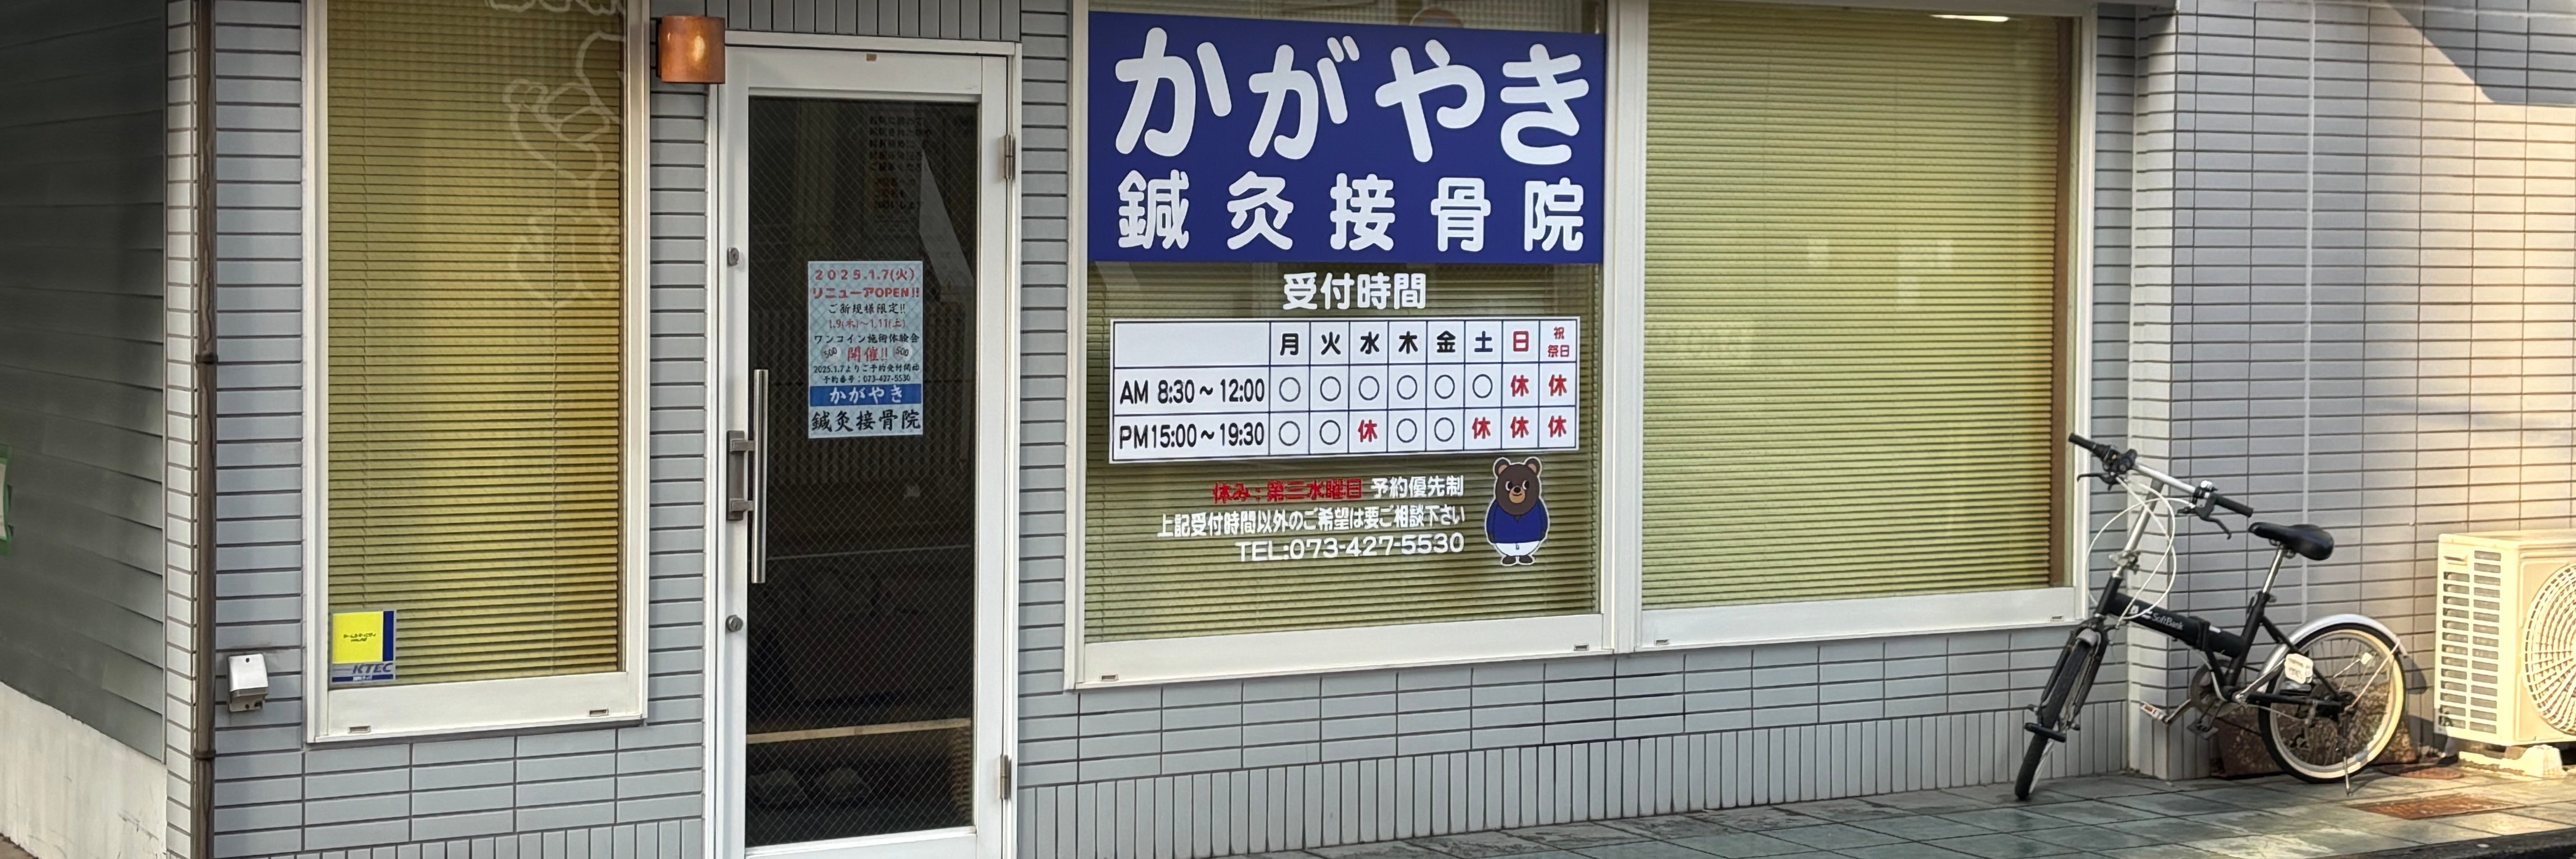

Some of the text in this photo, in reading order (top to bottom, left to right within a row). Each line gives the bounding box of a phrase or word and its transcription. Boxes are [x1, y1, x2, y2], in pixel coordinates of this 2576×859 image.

[1115, 28, 1589, 165] かがやき
[1118, 169, 1585, 252] 鍼灸接骨院
[1283, 272, 1427, 310] 受付時間
[1280, 330, 1530, 356] 月 火 水 木 金 土 日
[1553, 326, 1565, 340] 祝
[1548, 344, 1570, 358] 祭日
[829, 384, 902, 404] かがやき
[1120, 380, 1148, 405] AM
[1511, 374, 1529, 397] 休
[1548, 374, 1567, 397] 休
[811, 409, 921, 432] 鍼灸接骨院
[1358, 419, 1378, 443] 休
[1472, 417, 1491, 440] 休
[1510, 416, 1529, 439] 休
[1548, 415, 1567, 438] 休
[1371, 476, 1464, 499] 予約優先制
[1157, 503, 1465, 537] 上記受付時間以外のご希望は要ご相談下さい
[1235, 532, 1464, 562] TEL:073-427-5530
[2152, 613, 2183, 630] SoftBank
[353, 663, 393, 674] KTEC
